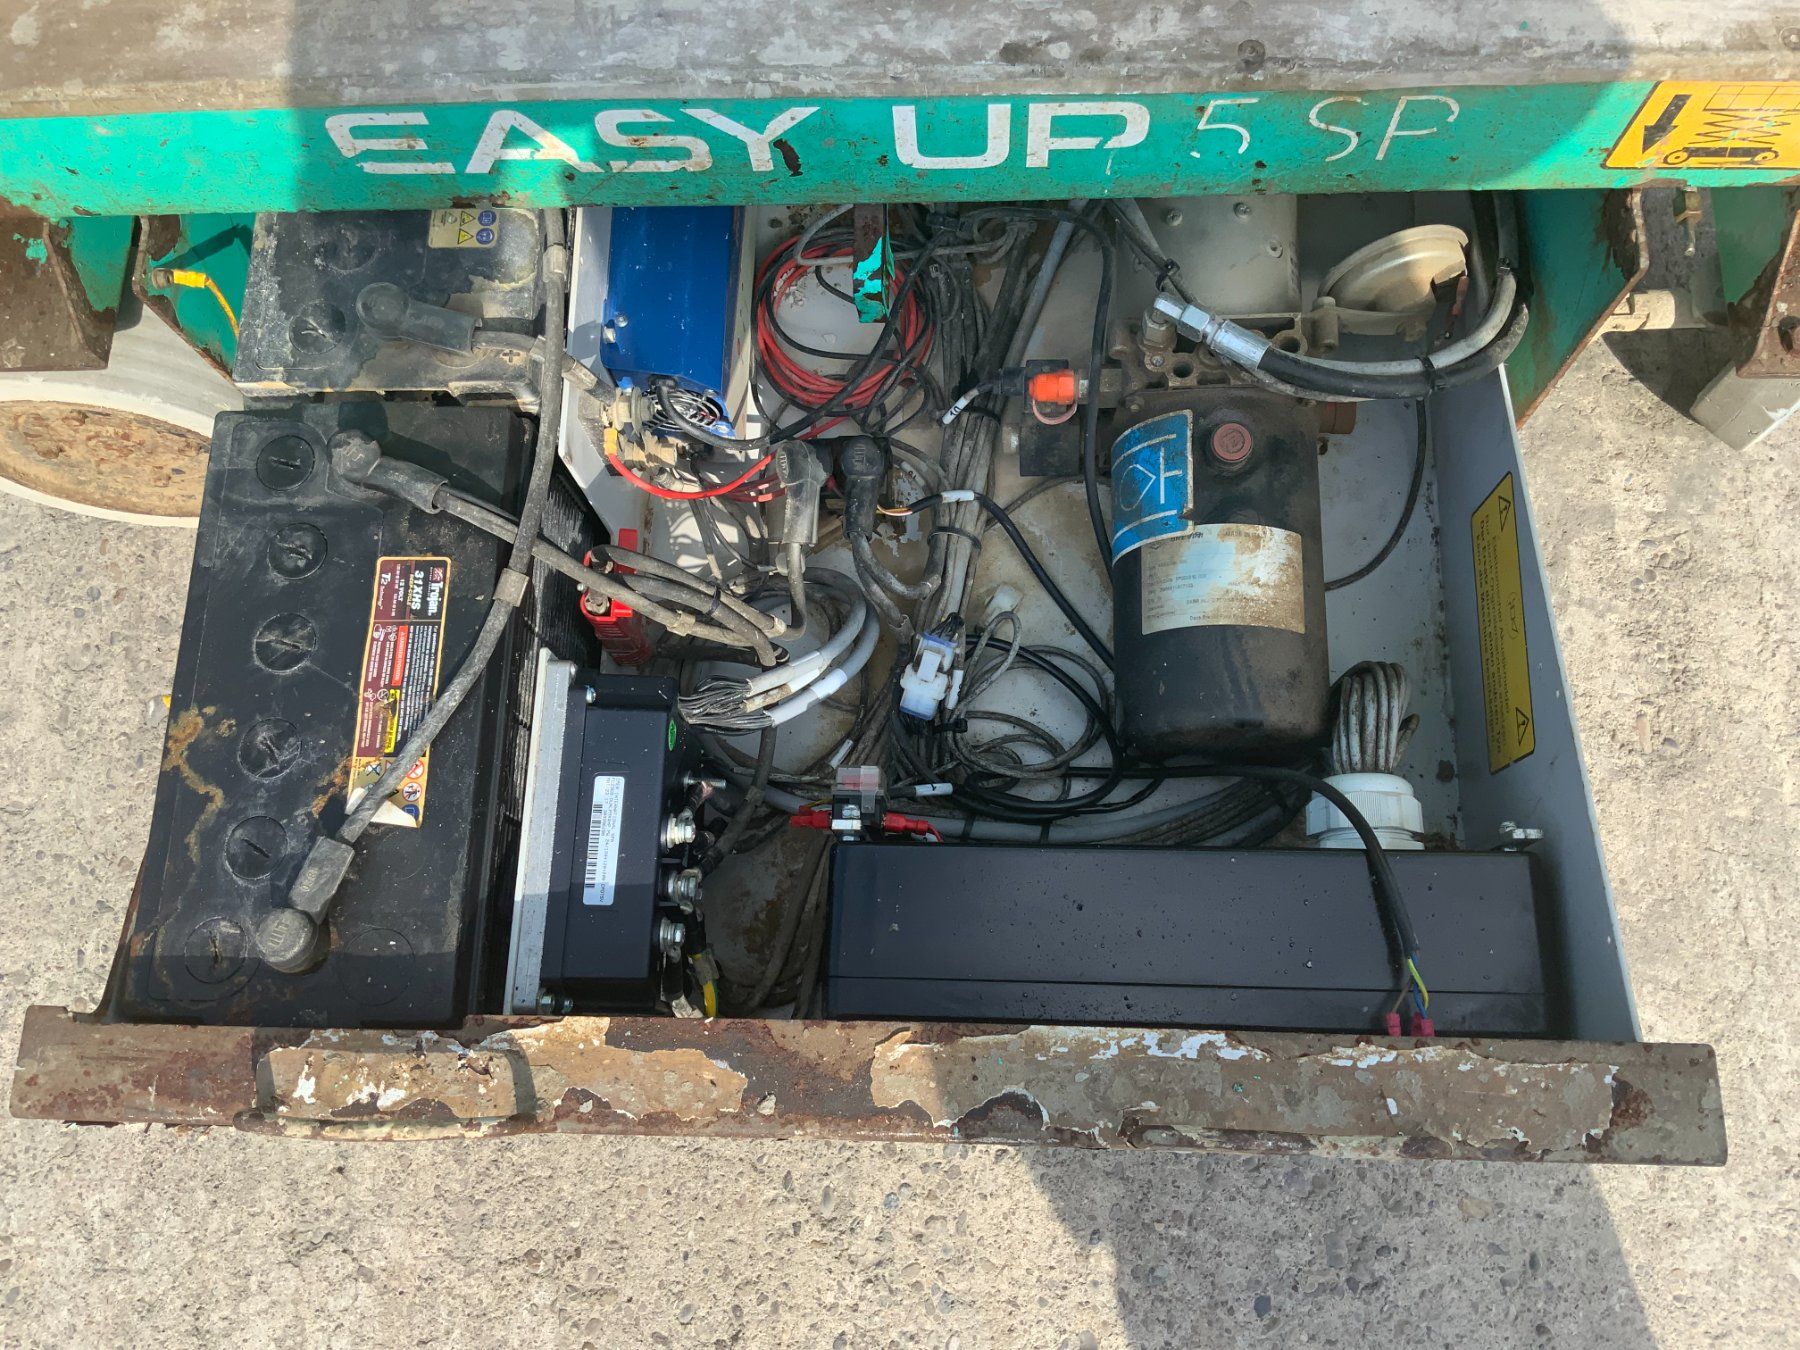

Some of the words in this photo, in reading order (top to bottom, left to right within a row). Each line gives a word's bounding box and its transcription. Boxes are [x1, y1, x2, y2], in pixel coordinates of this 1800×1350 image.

[325, 106, 820, 175] EASY
[891, 102, 1151, 170] UP
[1307, 95, 1461, 163] SP
[411, 570, 424, 610] 31XHS
[427, 581, 443, 613] Trojan
